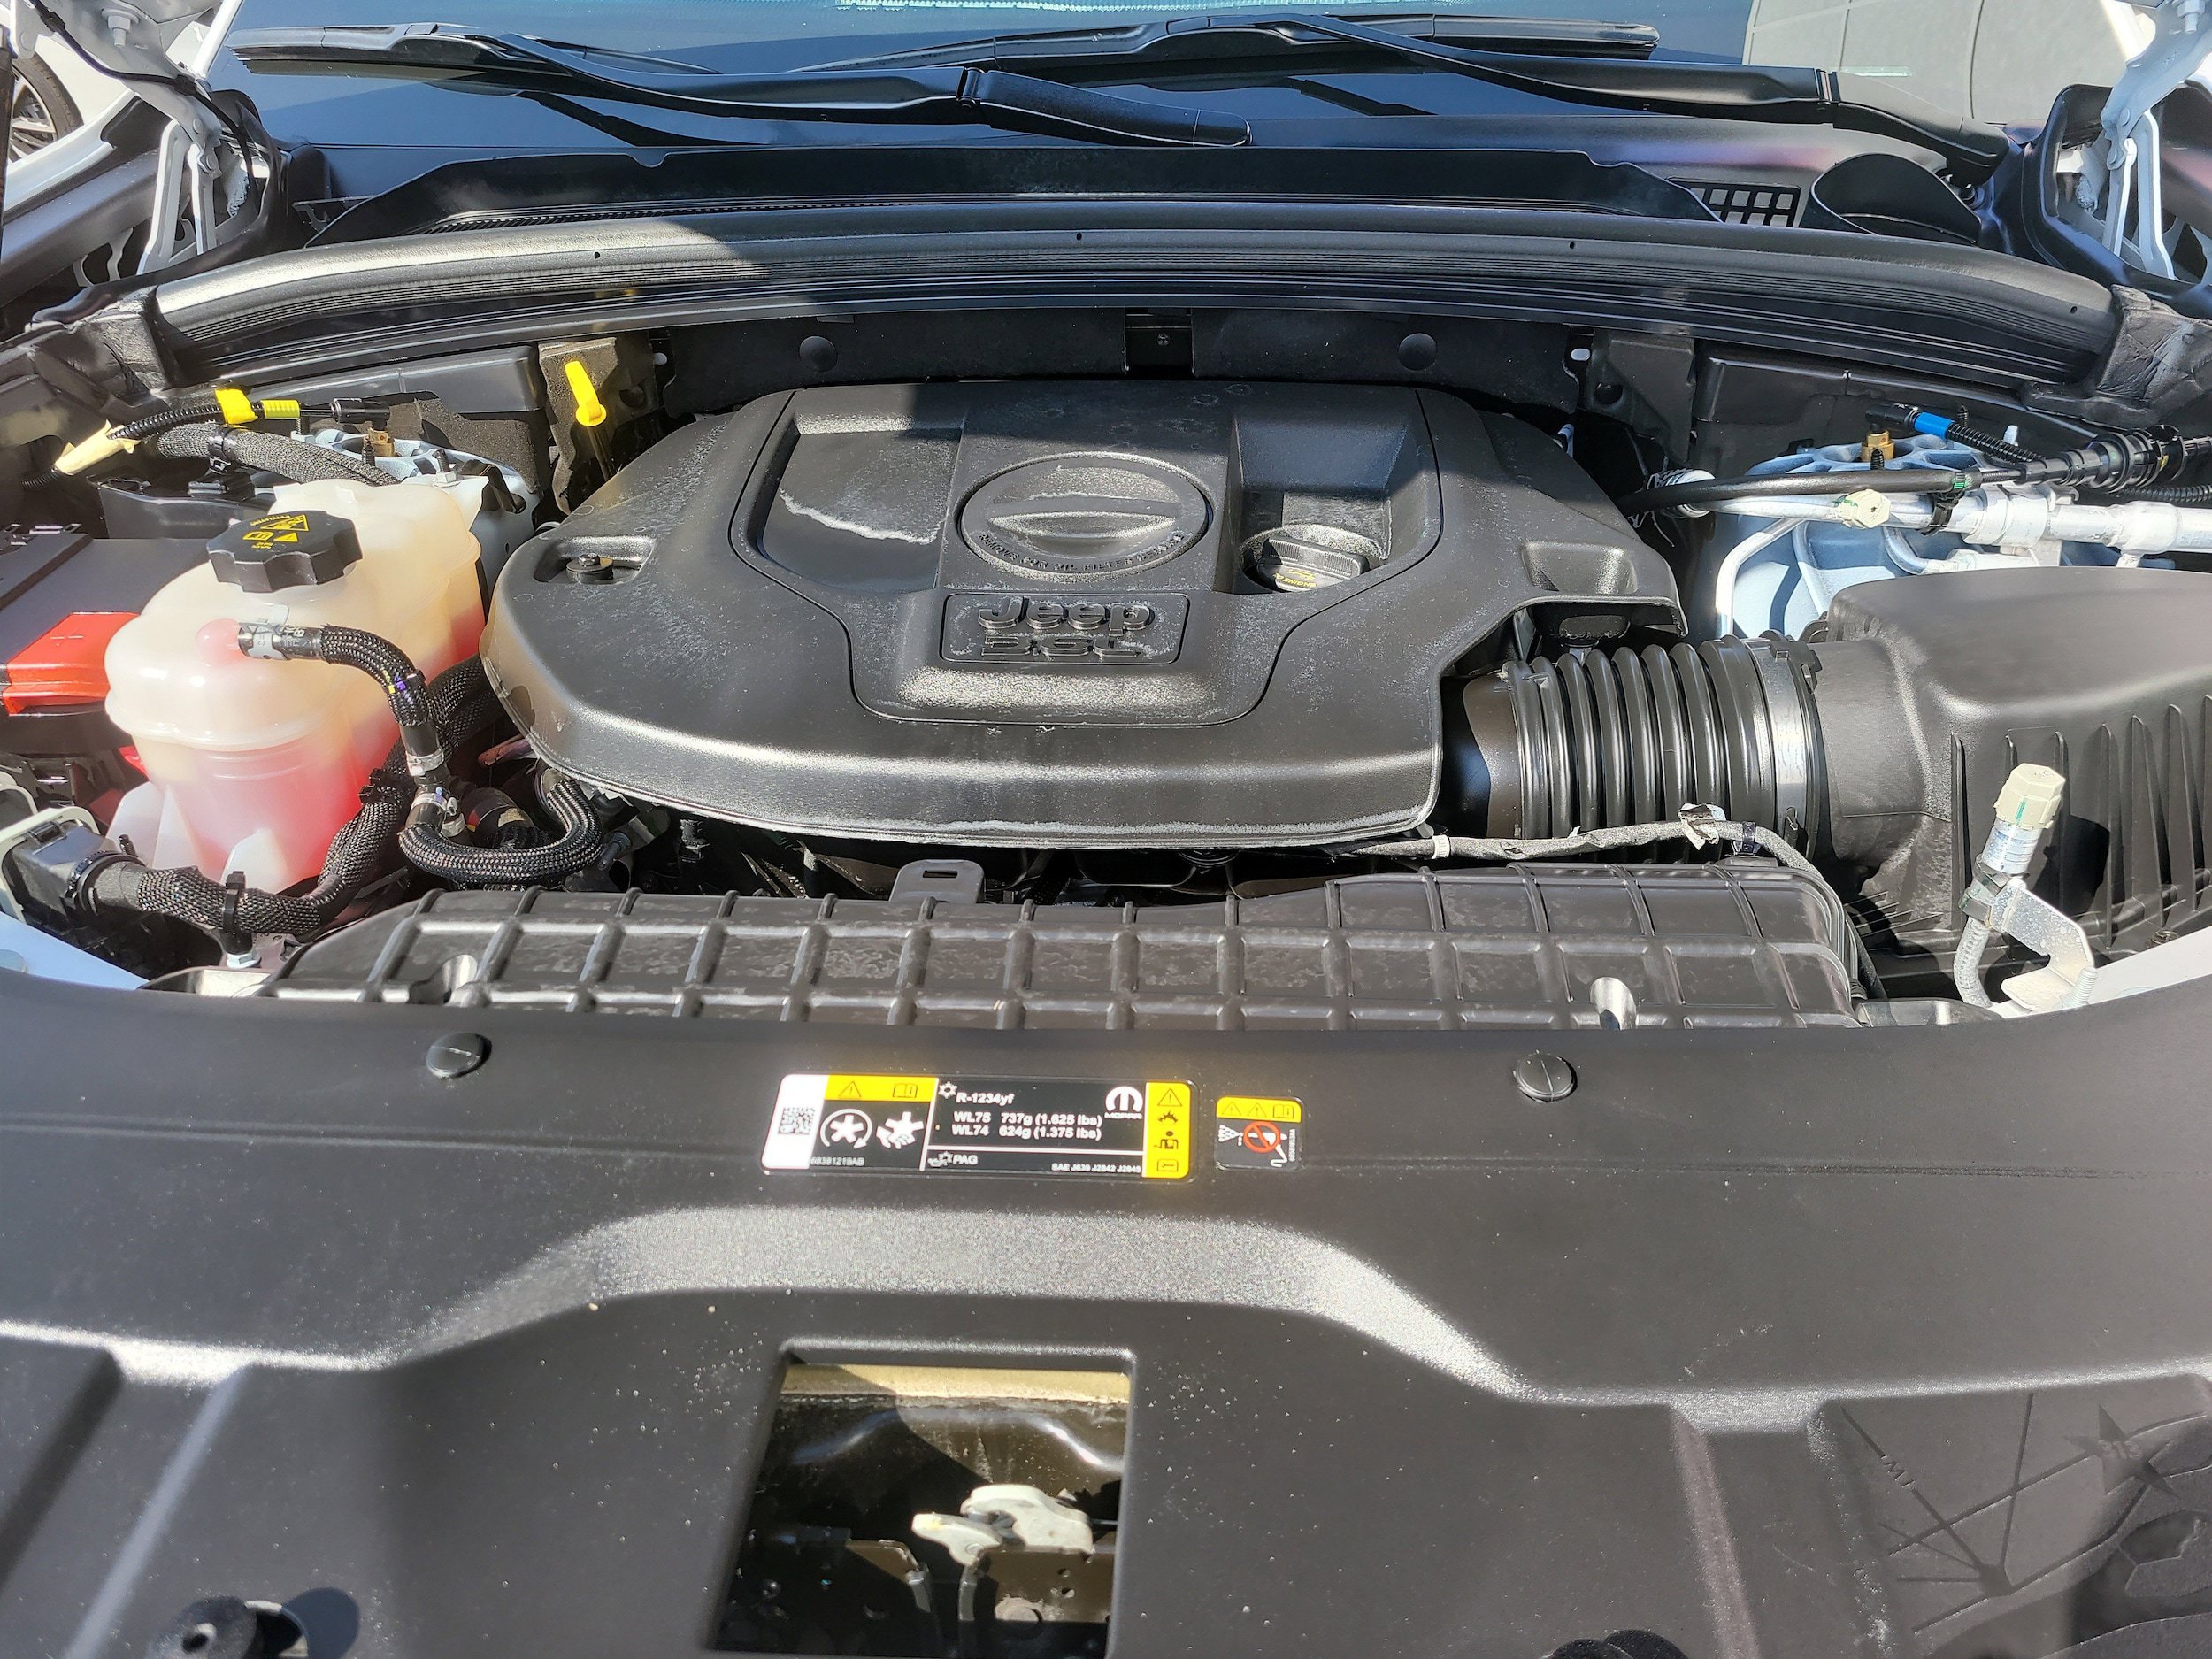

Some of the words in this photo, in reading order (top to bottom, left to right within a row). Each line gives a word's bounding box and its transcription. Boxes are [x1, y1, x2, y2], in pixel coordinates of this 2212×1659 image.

[978, 533, 1018, 562] REMOVE
[1019, 556, 1049, 570] FOR
[1053, 561, 1078, 572] OIL
[1084, 557, 1133, 572] FILTER
[978, 596, 1154, 637] Jeep
[956, 1092, 1015, 1106] R-1234yf
[953, 1111, 991, 1124] WL75
[1001, 1112, 1033, 1126] 737g
[1034, 1113, 1075, 1127] (1.625
[1077, 1114, 1102, 1128] lbs)
[951, 1124, 990, 1137] WL74
[998, 1125, 1032, 1140] 624g
[1033, 1125, 1074, 1141] (1.375
[1075, 1127, 1102, 1141] lbs)
[952, 1154, 979, 1165] PAG
[1051, 1162, 1071, 1172] SAE
[2097, 1439, 2143, 1460] 313
